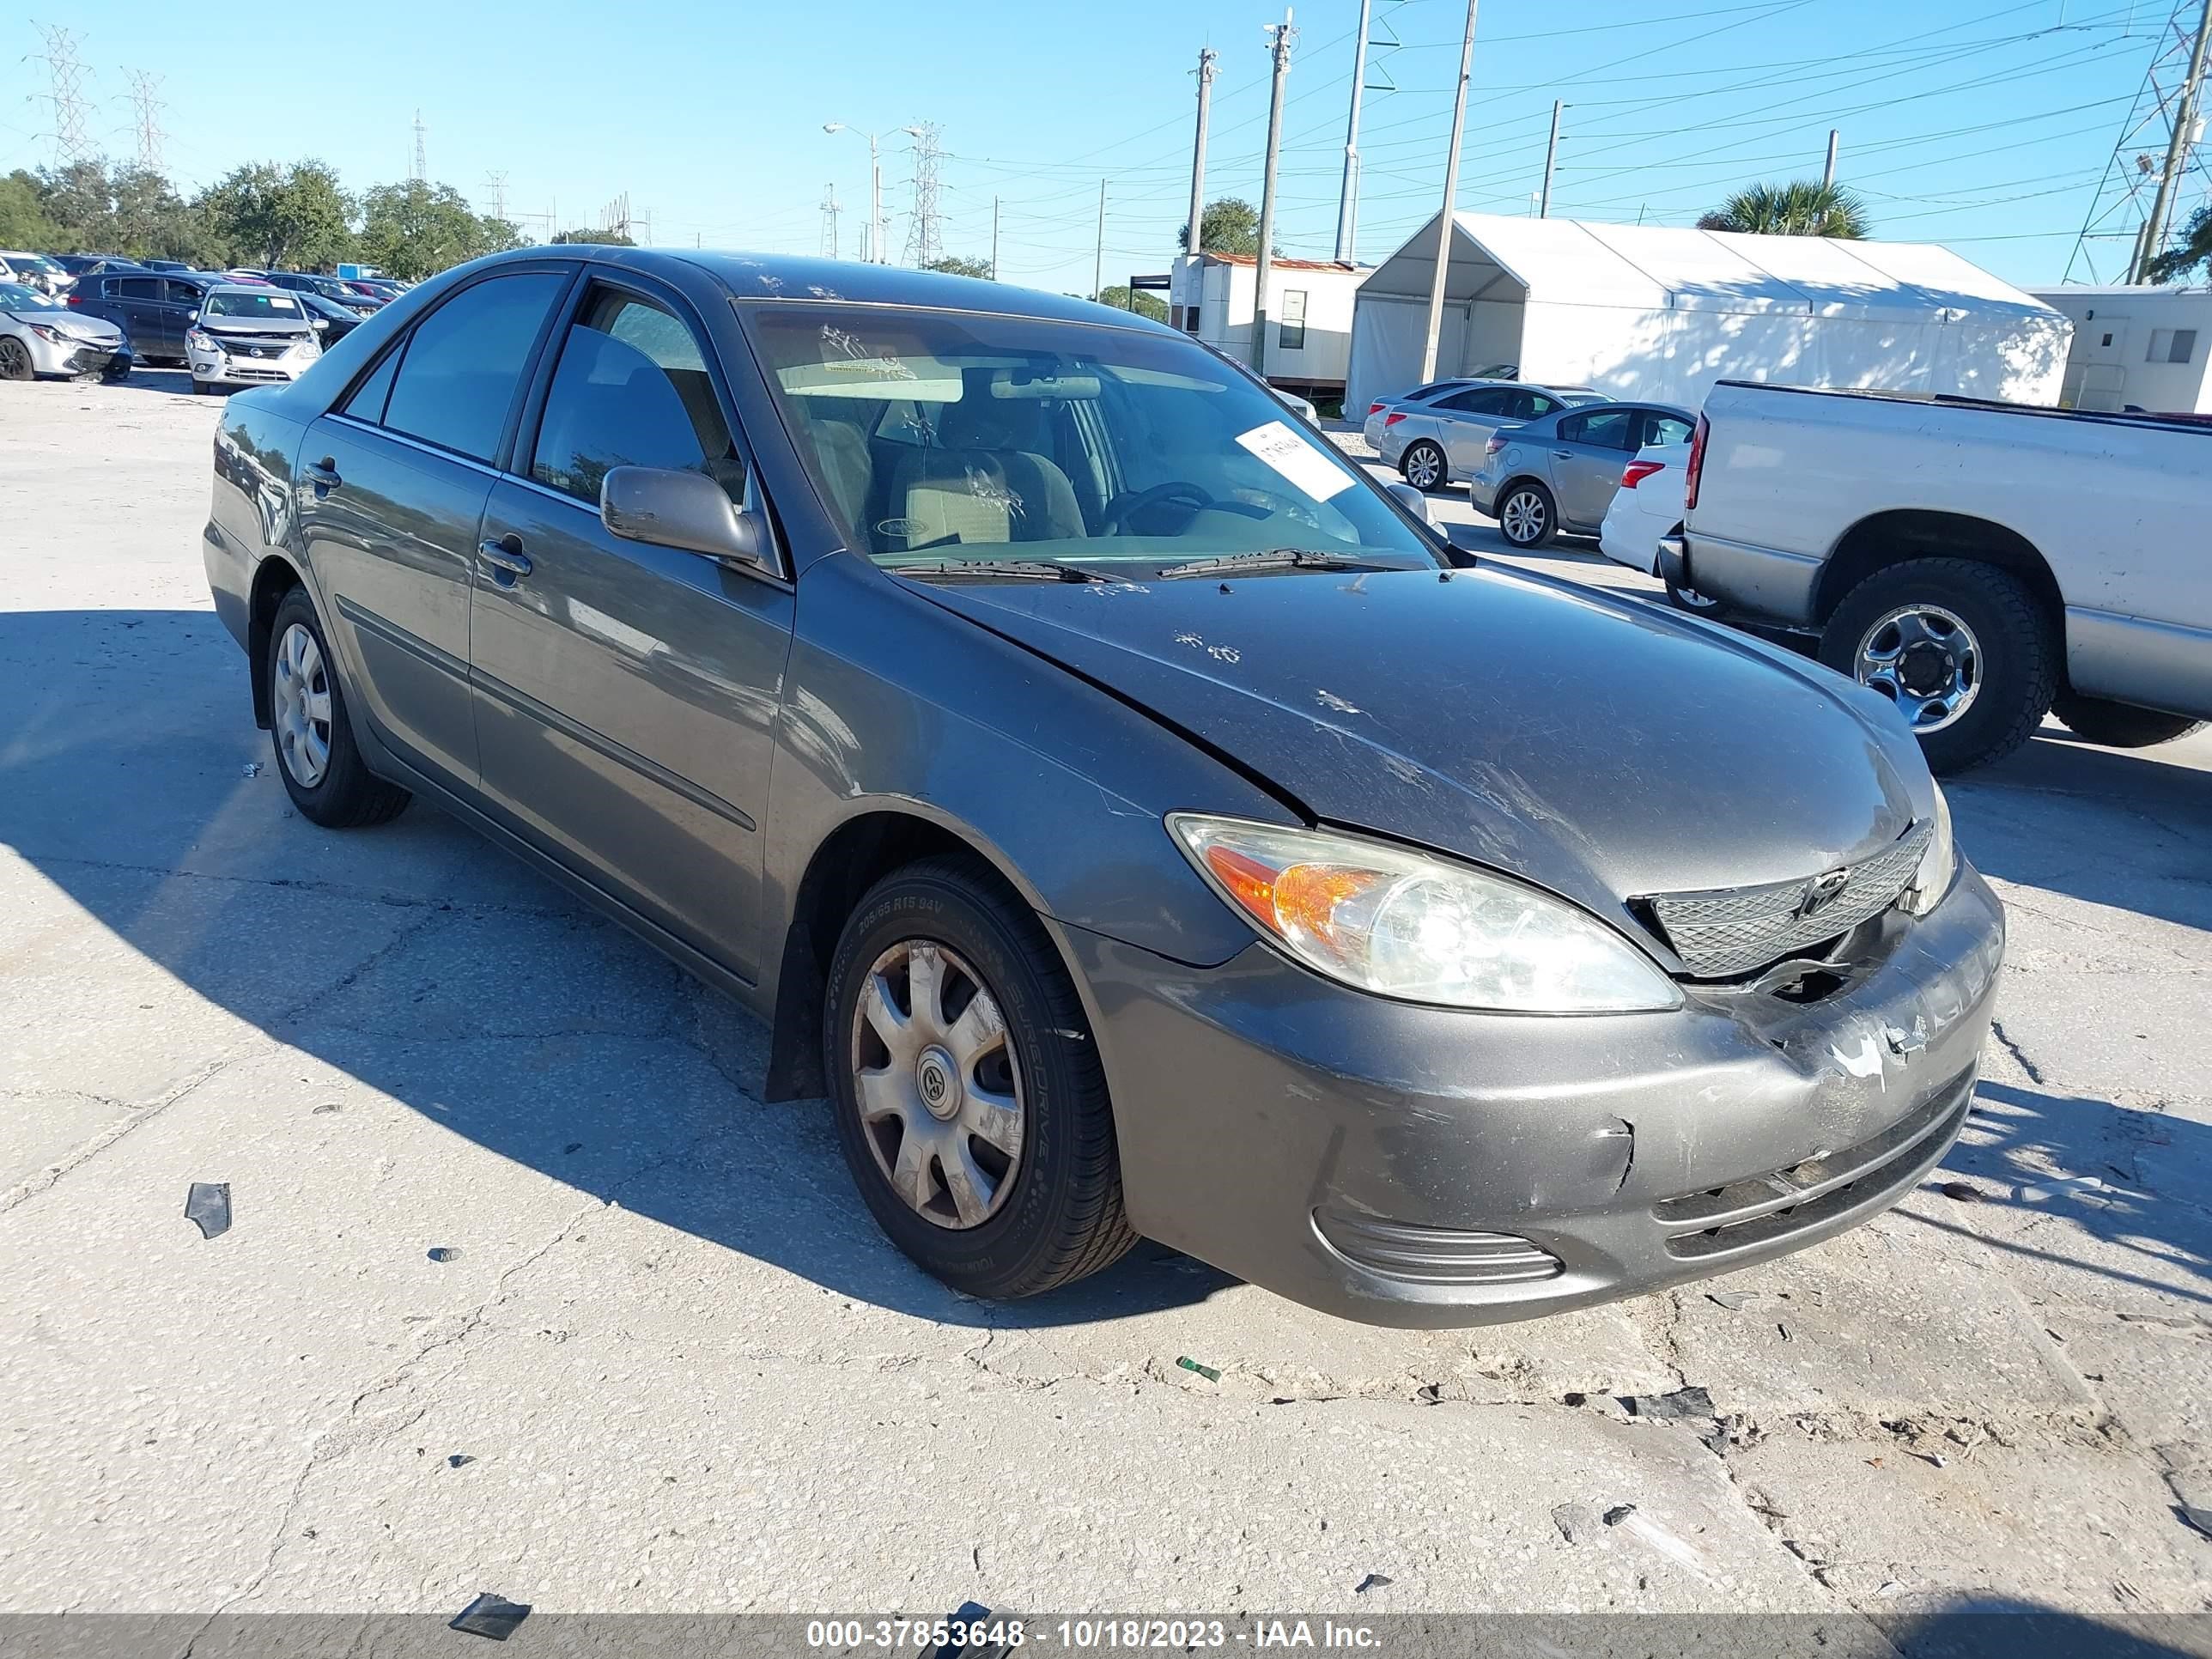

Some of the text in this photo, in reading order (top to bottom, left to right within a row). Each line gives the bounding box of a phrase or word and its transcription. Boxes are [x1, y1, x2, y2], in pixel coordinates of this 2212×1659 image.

[858, 900, 890, 937] 205/65
[893, 896, 916, 911] R15
[1006, 981, 1050, 1164] SUREDRIVE
